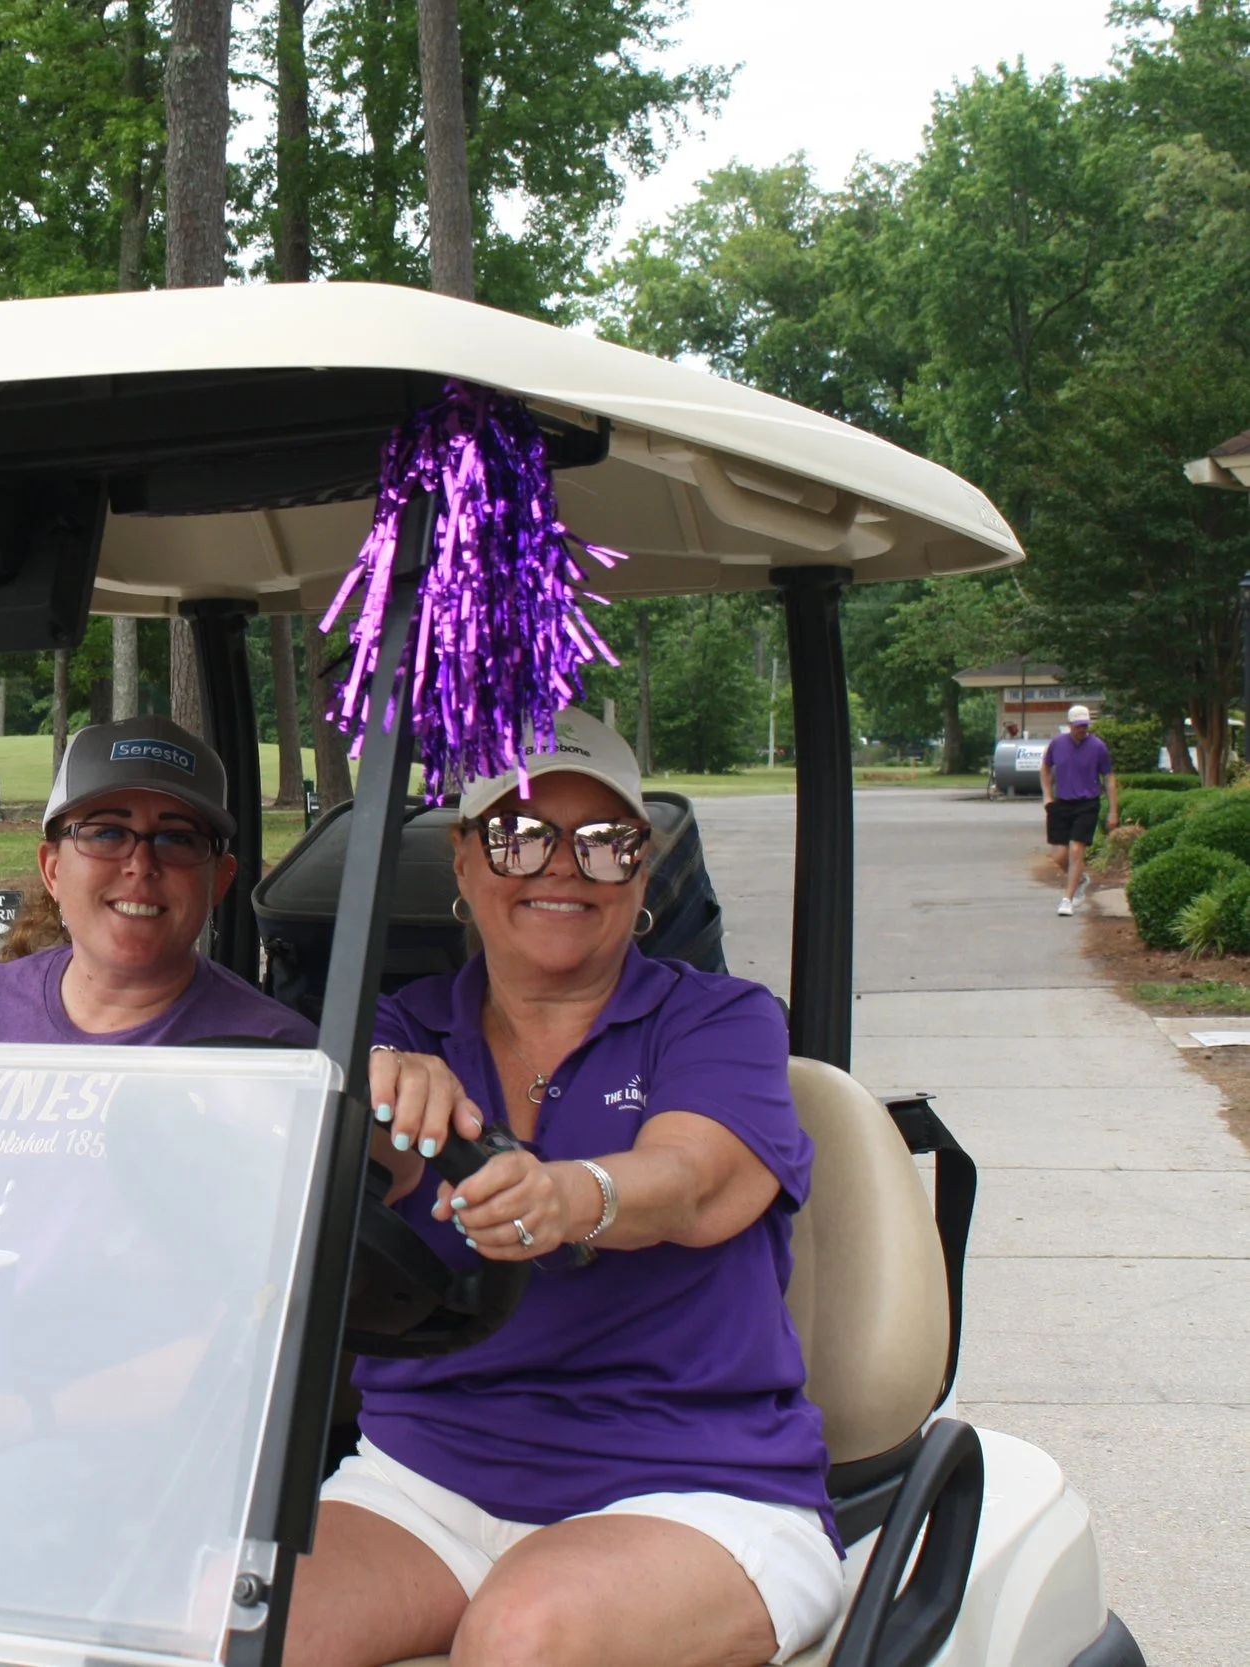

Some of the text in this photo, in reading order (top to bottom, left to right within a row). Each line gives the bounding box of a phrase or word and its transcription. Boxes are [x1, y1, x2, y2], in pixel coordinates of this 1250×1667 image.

[118, 744, 189, 768] Seresto
[603, 1089, 623, 1105] THE
[65, 1129, 107, 1160] 185
